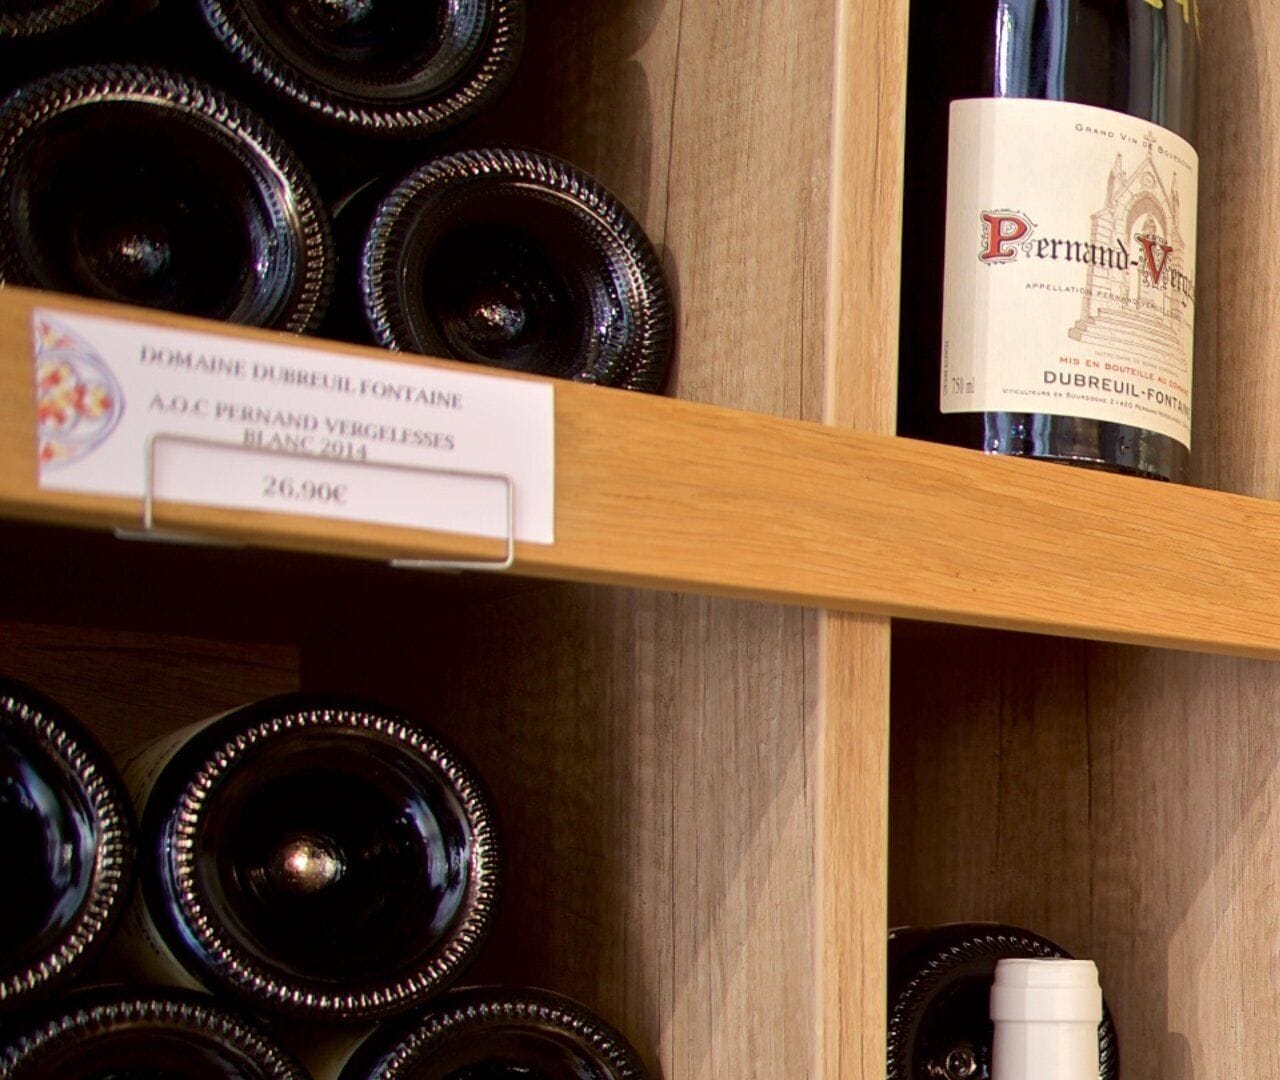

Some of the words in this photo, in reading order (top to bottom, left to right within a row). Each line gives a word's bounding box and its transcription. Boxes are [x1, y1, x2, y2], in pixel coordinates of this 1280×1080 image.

[140, 345, 246, 377] DOMAINE
[251, 362, 356, 395] DUBREUIL
[358, 378, 463, 409] FONTAINE
[1059, 356, 1080, 366] MIS
[1085, 359, 1100, 368] EN
[1104, 363, 1155, 382] BOUTEILLE
[215, 402, 318, 432] PERNAND
[324, 417, 455, 450] VERGELESSES
[242, 427, 314, 452] BLANC
[319, 438, 368, 461] 2014
[263, 475, 348, 503] 26.90€
